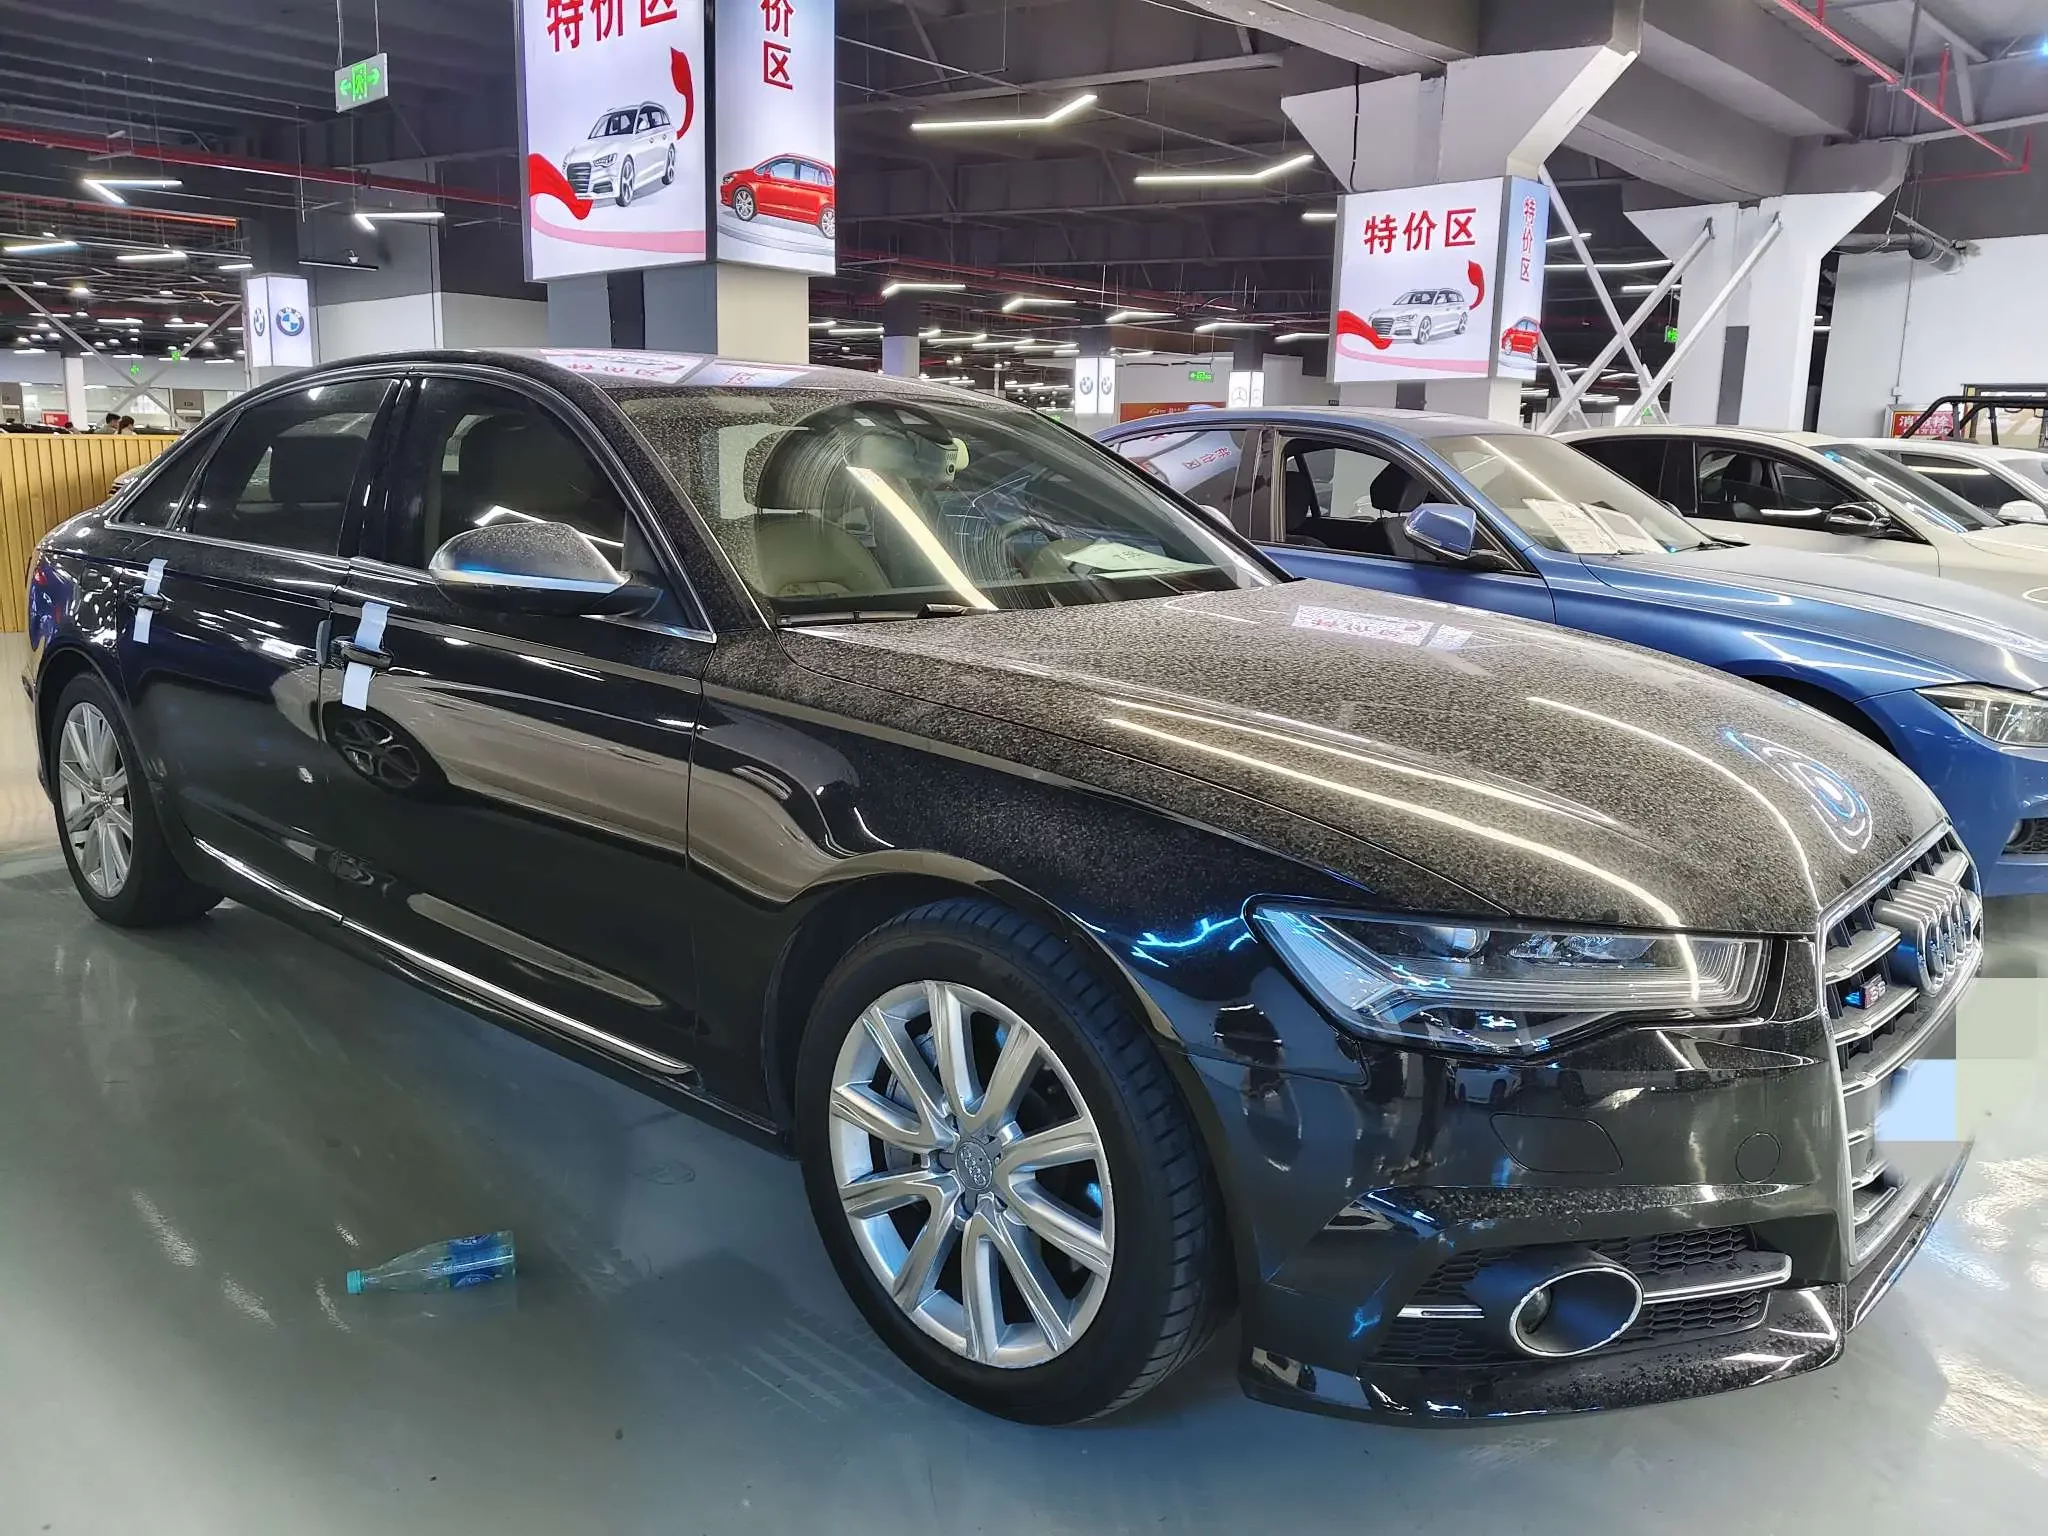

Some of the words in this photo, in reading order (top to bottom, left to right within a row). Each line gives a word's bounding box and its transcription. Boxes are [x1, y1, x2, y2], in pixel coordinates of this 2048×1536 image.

[1364, 208, 1476, 254] 特价区
[1520, 196, 1536, 282] 特价区
